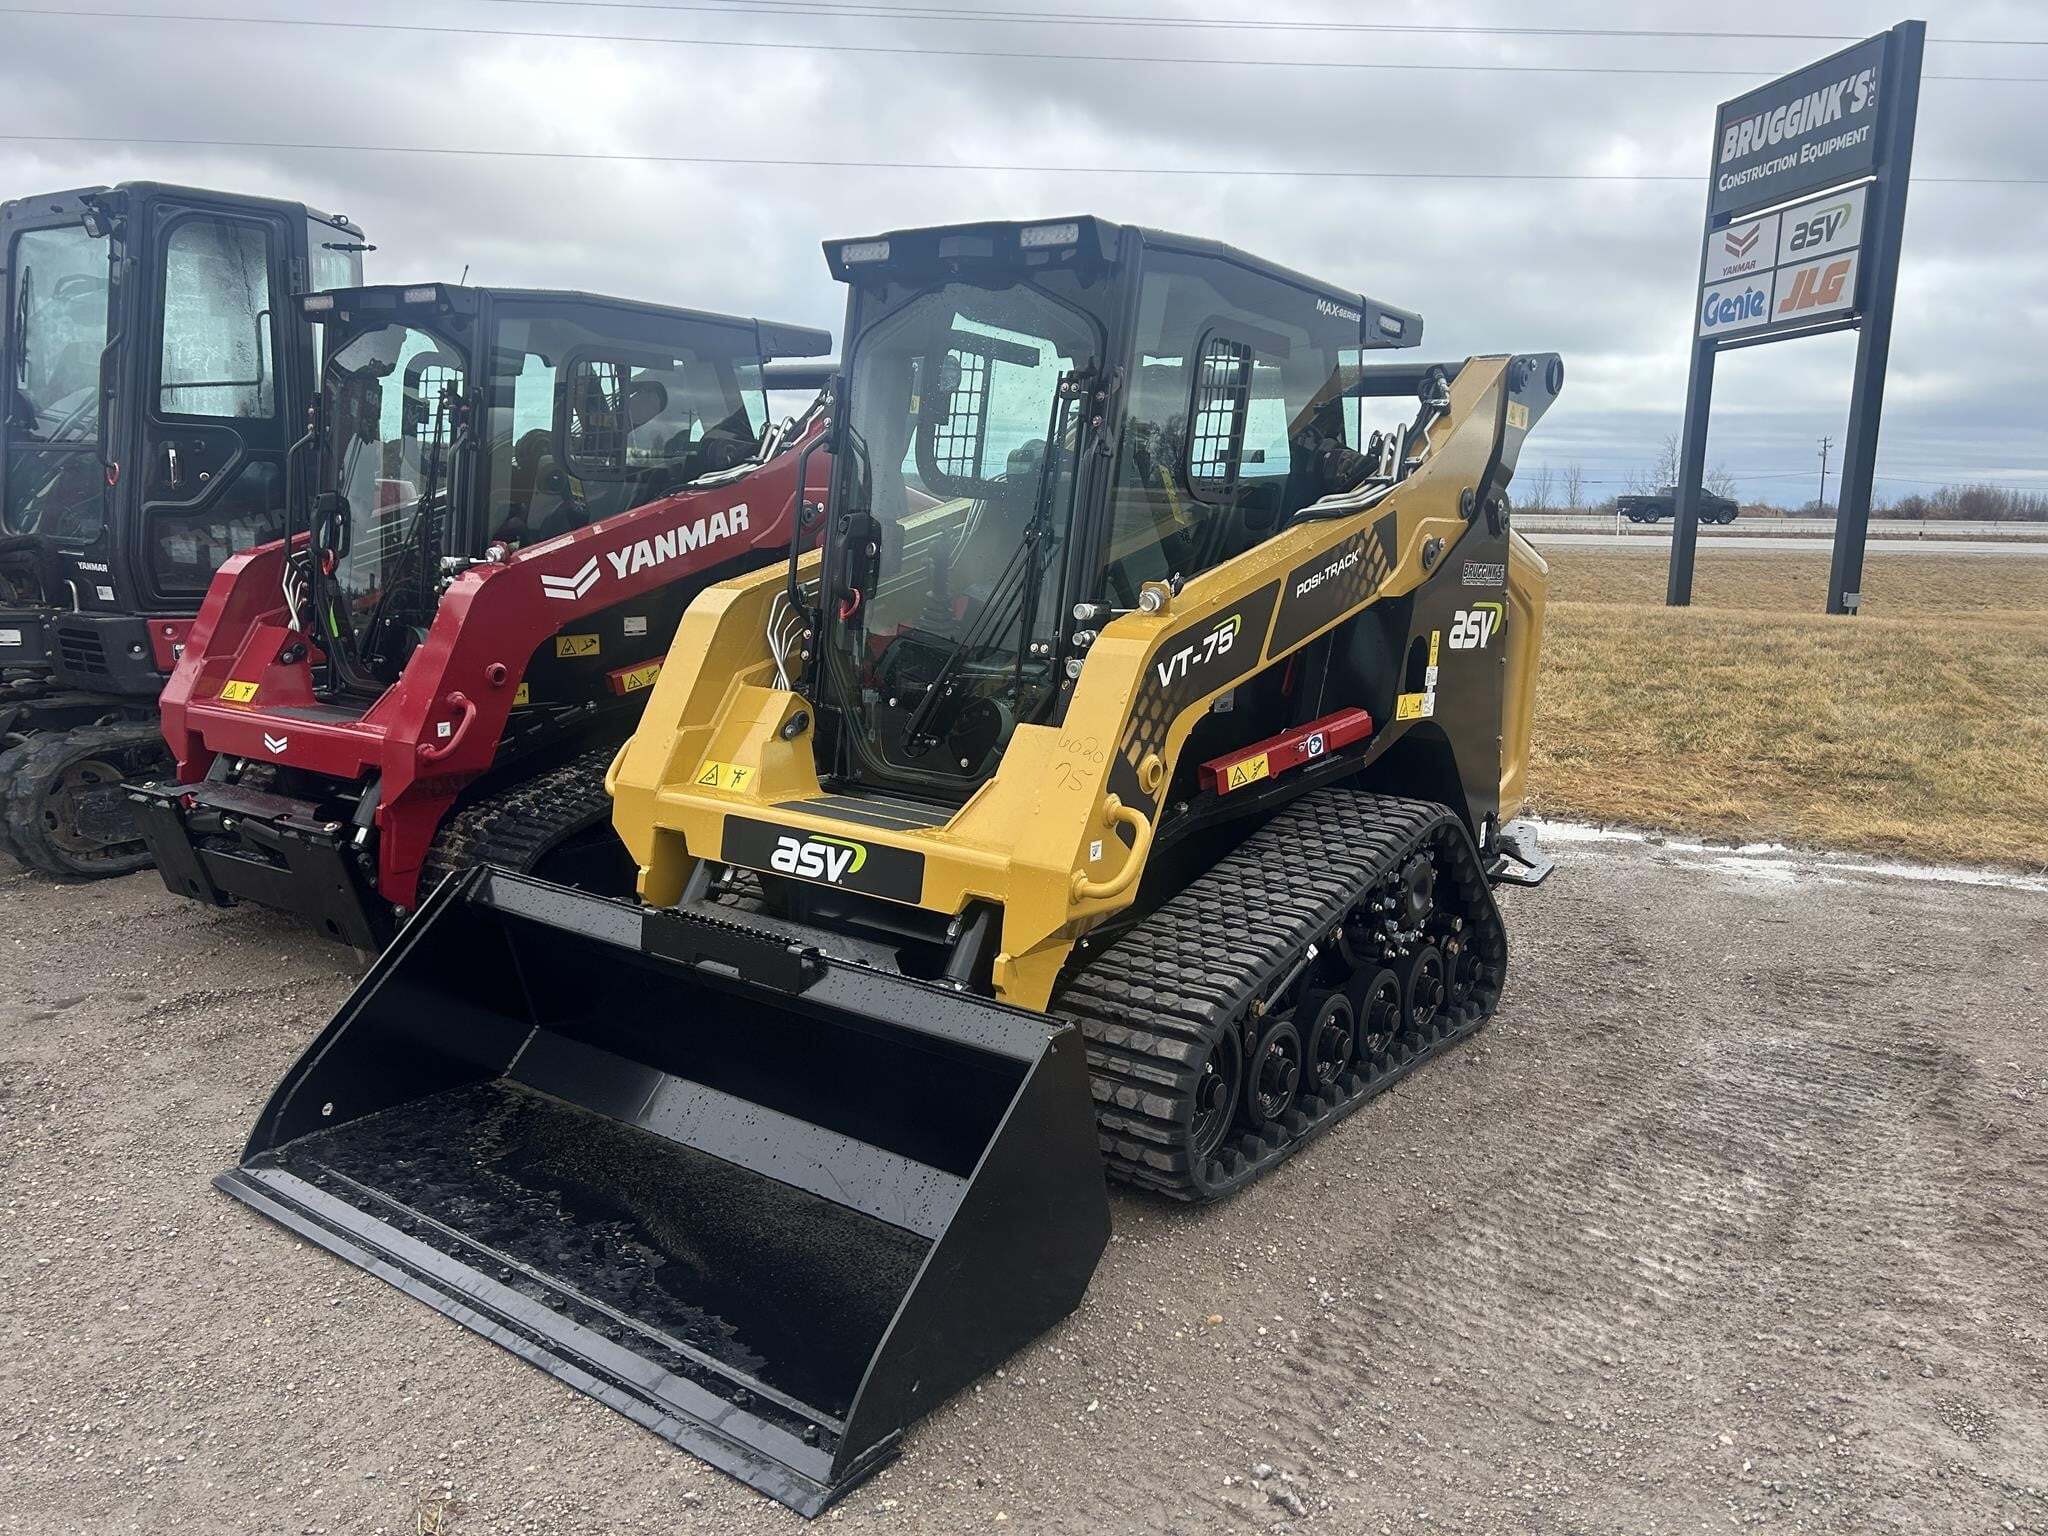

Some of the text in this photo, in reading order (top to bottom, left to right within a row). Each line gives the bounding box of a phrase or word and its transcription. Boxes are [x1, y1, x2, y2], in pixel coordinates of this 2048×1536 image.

[1720, 69, 1871, 164] BRUGGINK'S
[1718, 125, 1870, 192] CONSTRUCTION EQUIPMENT
[1722, 260, 1756, 277] YANMAR
[1777, 259, 1852, 314] JLG
[1704, 286, 1765, 327] Genie
[77, 561, 108, 572] YANMAR
[606, 503, 749, 580] YANMAR
[1296, 550, 1359, 599] POSI-TRACK
[1157, 623, 1233, 688] VT-75
